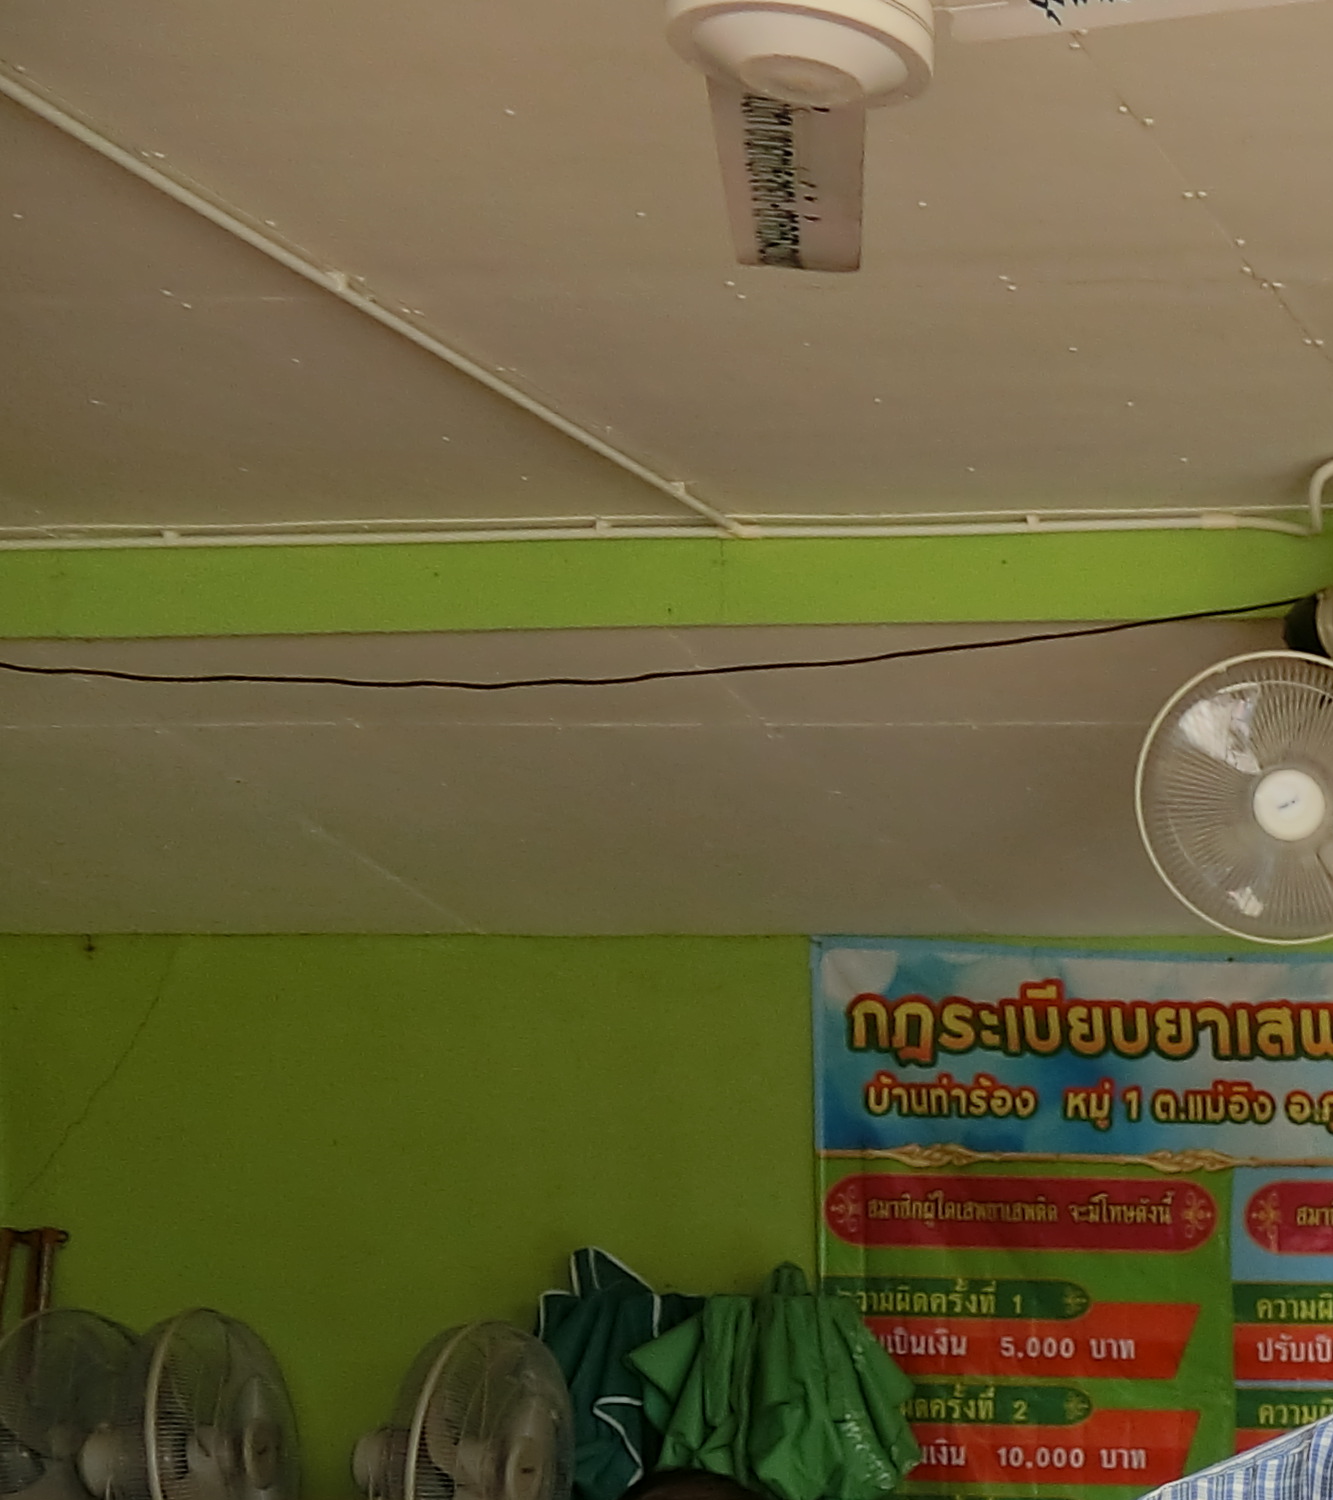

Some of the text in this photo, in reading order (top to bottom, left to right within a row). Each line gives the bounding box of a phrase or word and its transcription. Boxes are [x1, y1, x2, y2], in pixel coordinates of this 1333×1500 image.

[866, 1072, 1037, 1118] บ้านท่าร้อง
[1063, 1079, 1114, 1130] หมู่
[1125, 1088, 1140, 1118] 1
[1013, 1294, 1022, 1315] 1
[1089, 1337, 1136, 1360] บาท
[1012, 1399, 1028, 1420] 2
[1099, 1448, 1148, 1470] บาท
